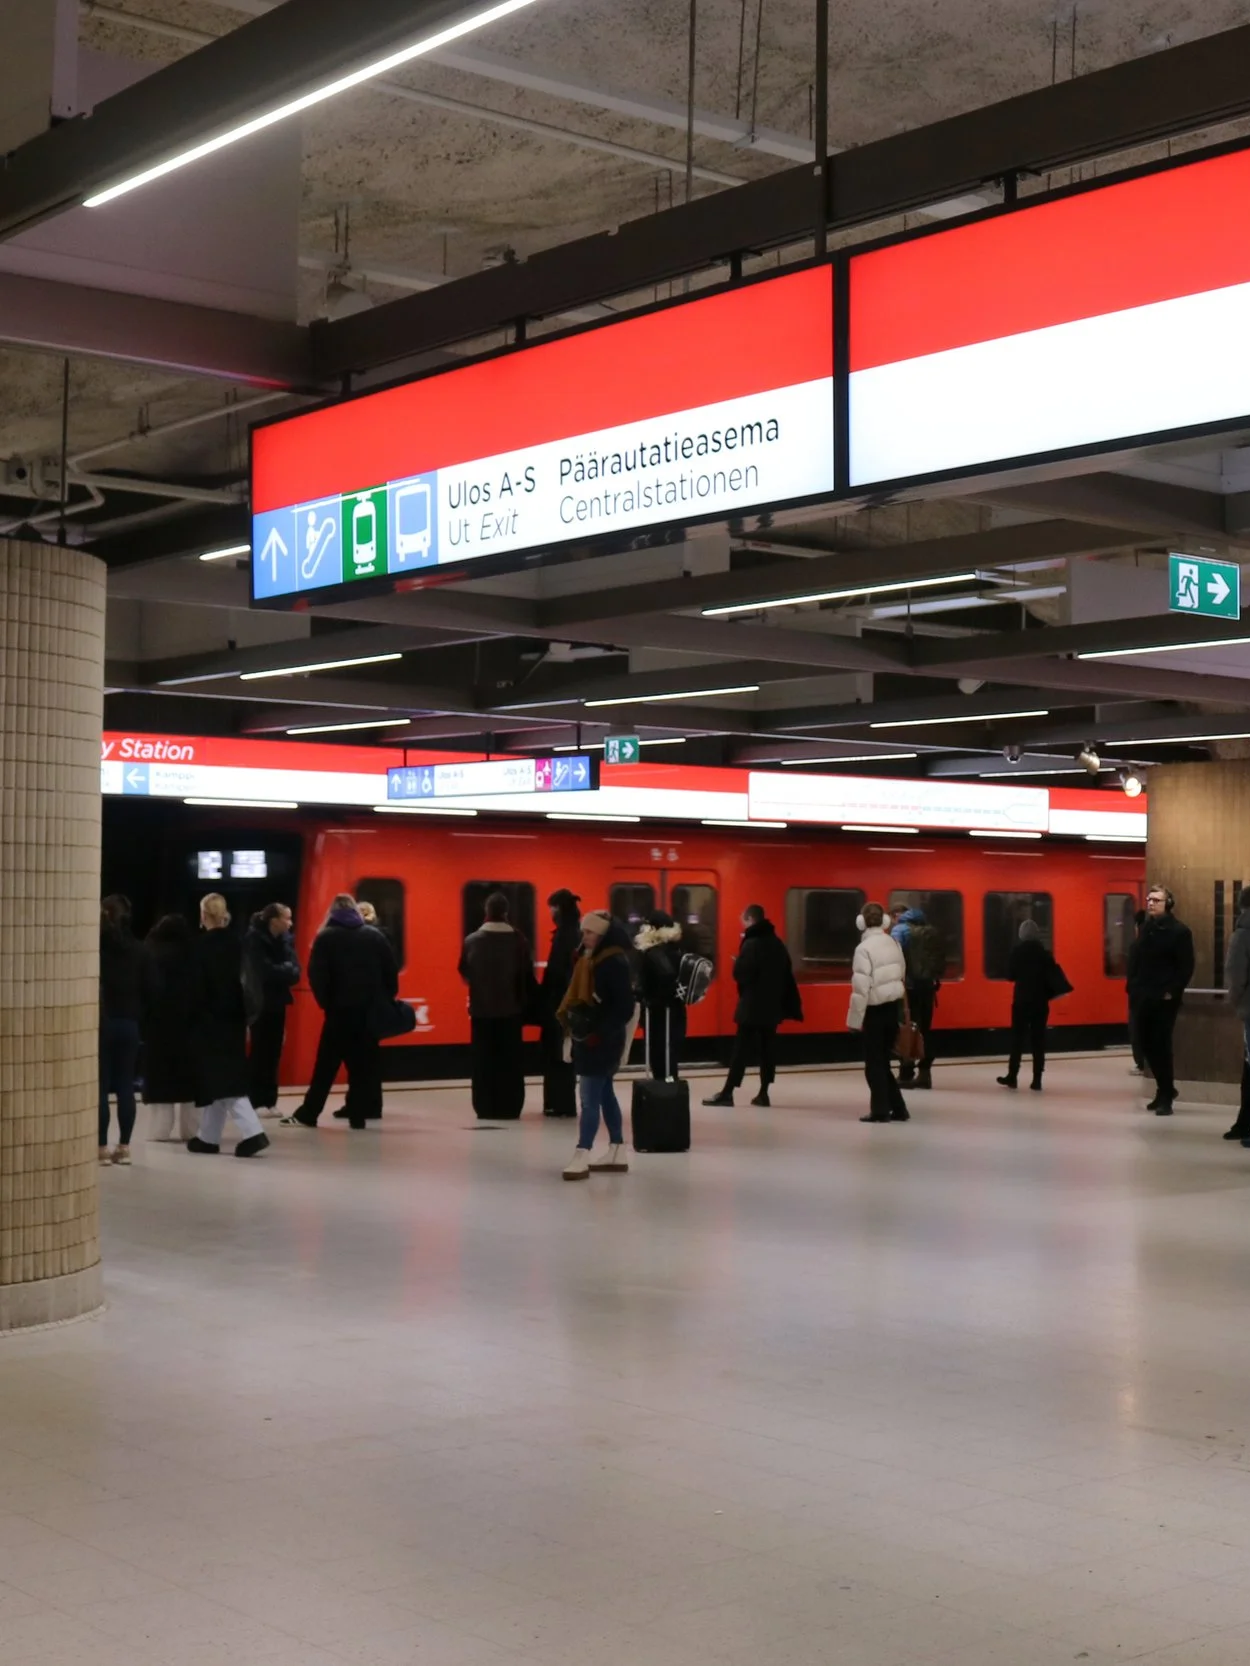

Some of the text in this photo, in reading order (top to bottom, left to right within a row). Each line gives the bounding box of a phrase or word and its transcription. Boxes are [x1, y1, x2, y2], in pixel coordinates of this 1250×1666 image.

[447, 418, 780, 510] Ulos A-S Päärautatieasema
[448, 464, 760, 547] Ut Exit Centralstationen
[118, 737, 195, 761] Station
